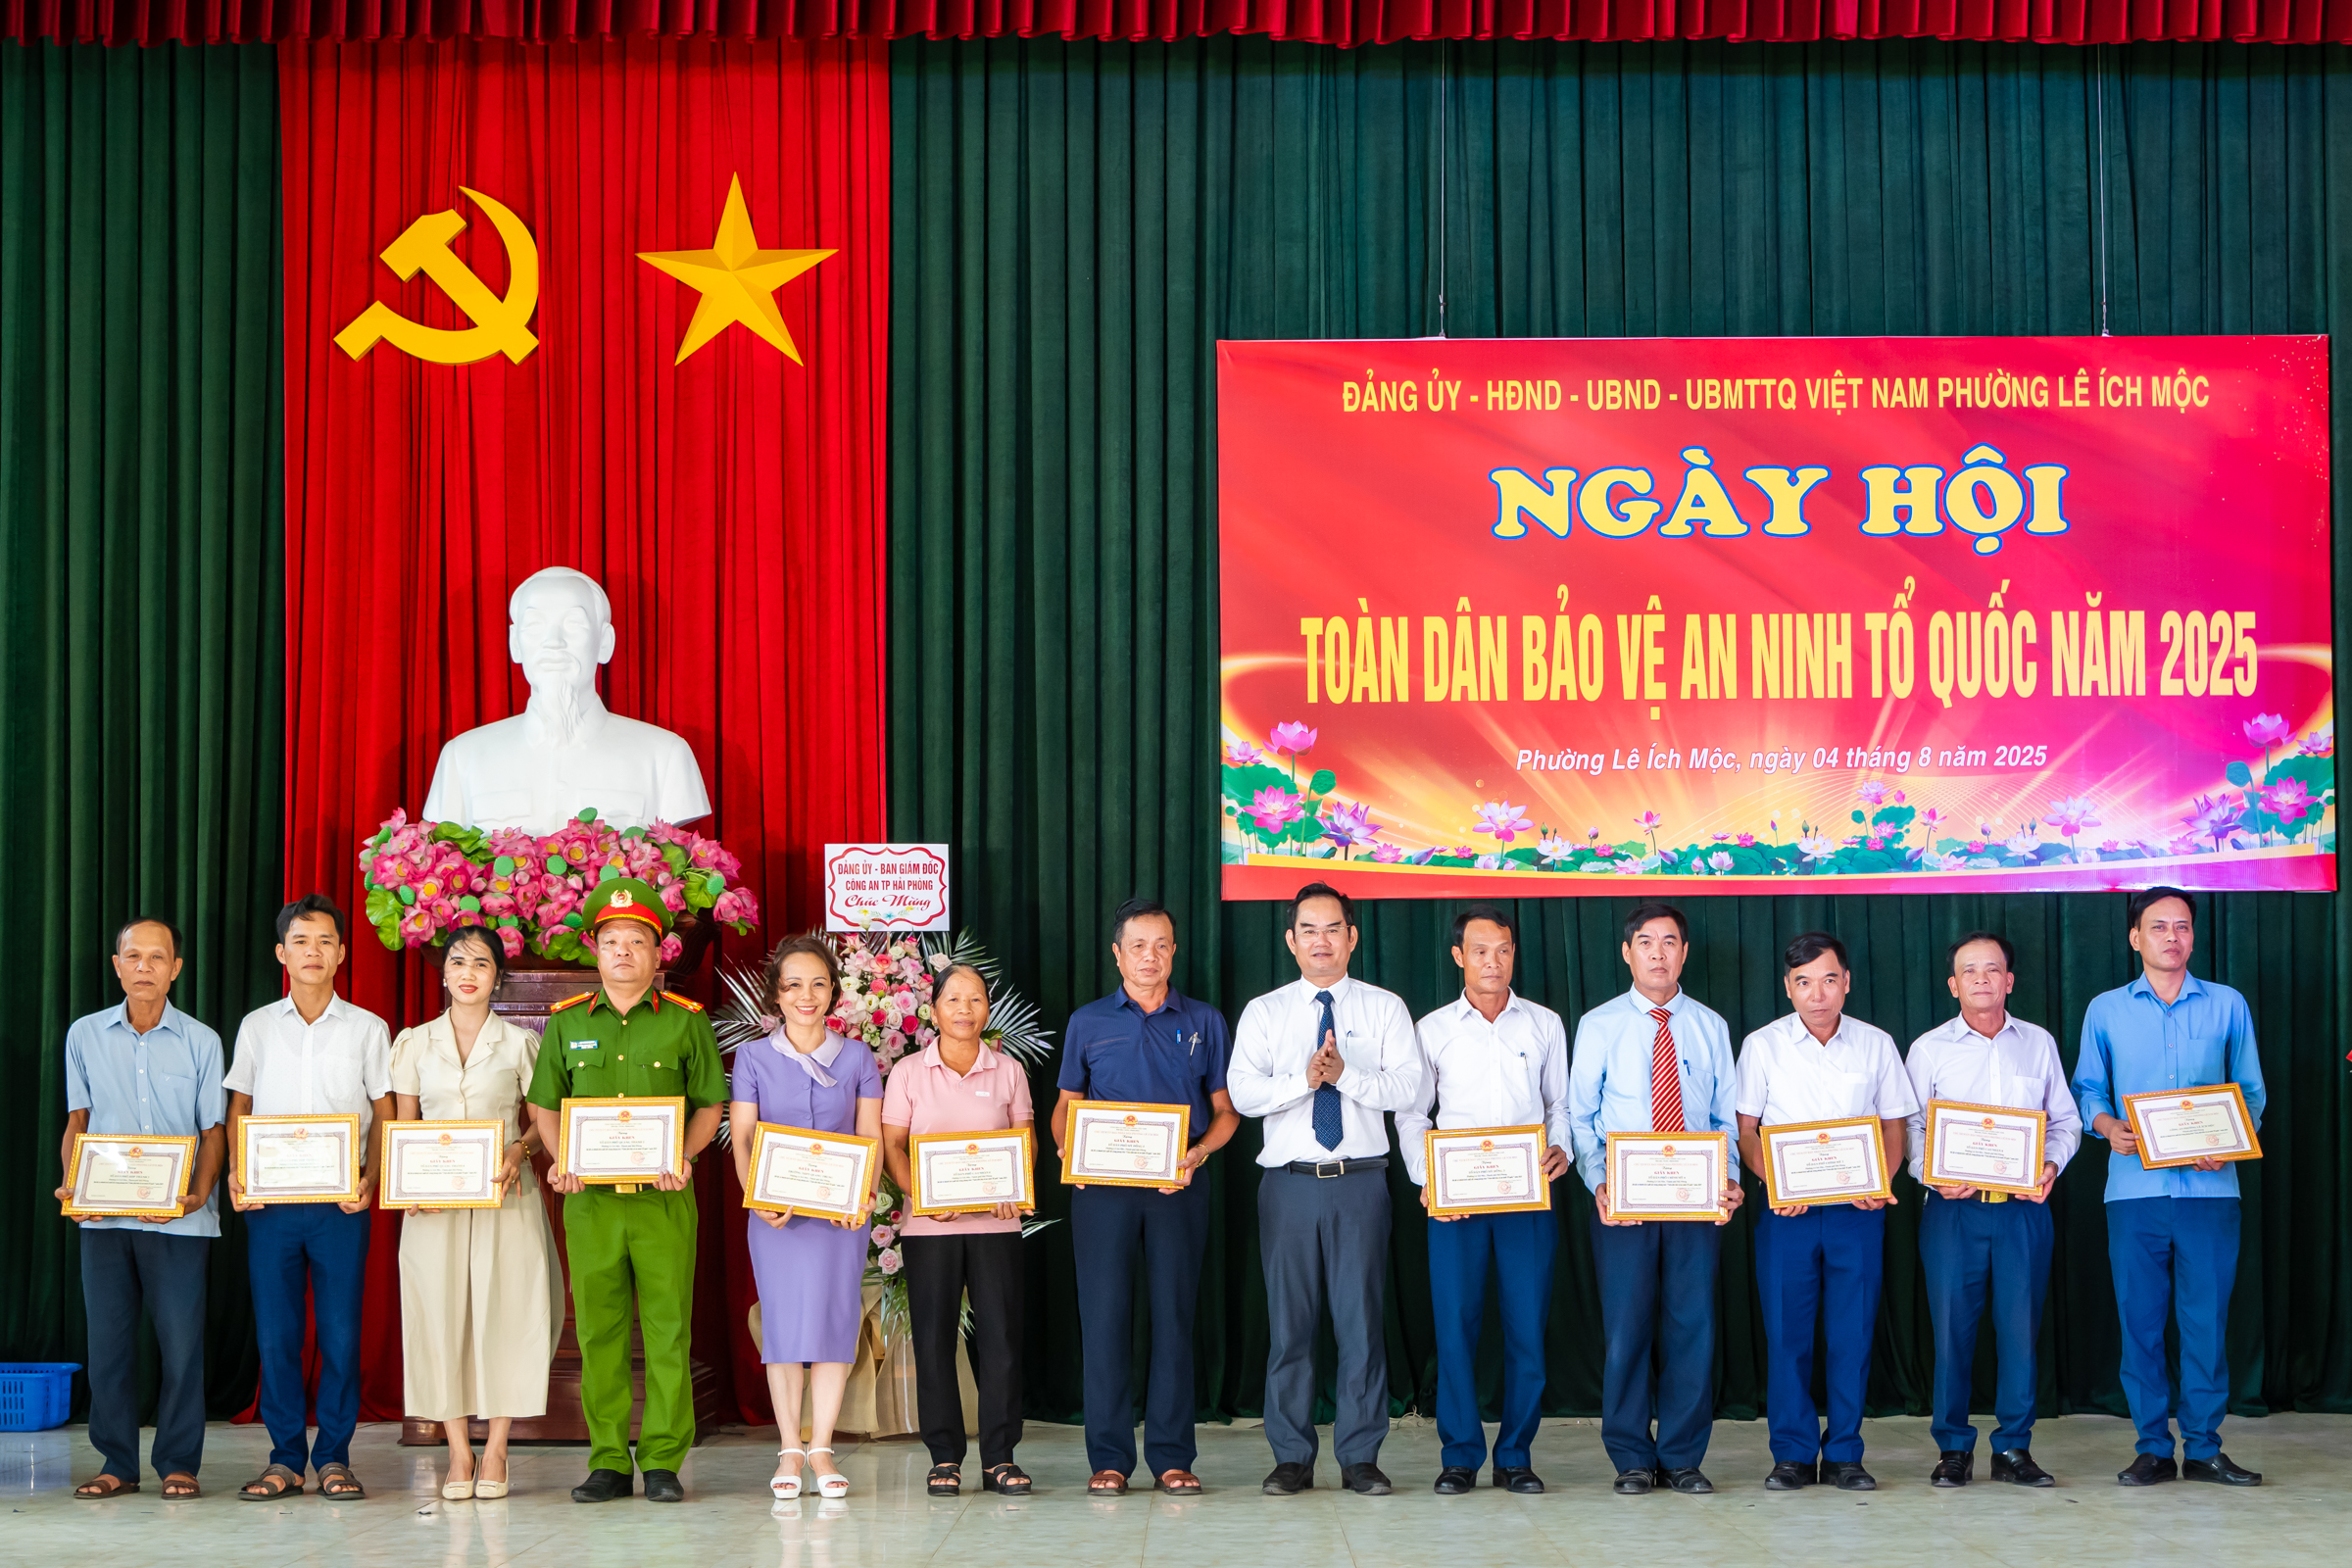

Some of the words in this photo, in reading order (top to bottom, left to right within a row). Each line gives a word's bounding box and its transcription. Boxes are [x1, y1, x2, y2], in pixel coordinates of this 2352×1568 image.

[1343, 368, 1417, 412] ĐẢNG
[1427, 368, 1461, 412] ỦY
[1470, 394, 1479, 403] -
[1487, 379, 1562, 411] HĐND
[1570, 394, 1579, 403] -
[1587, 379, 1661, 411] UBND
[1669, 393, 1678, 402] -
[1686, 378, 1796, 411] UBMTTQ
[1805, 369, 1863, 416] VIỆT
[1872, 377, 1929, 409] NAM
[1938, 368, 2049, 409] PHƯỜNG
[2058, 368, 2090, 408] LÊ
[2098, 368, 2142, 408] ÍCH
[2151, 368, 2210, 414] MỘC
[1489, 446, 1832, 540] NGÀY
[1858, 442, 2071, 557] HỘI
[1300, 598, 1409, 704] TOÀN
[1423, 596, 1508, 703] DÂN
[1522, 584, 1604, 702] BẢO
[1616, 595, 1666, 720] VỆ
[1680, 613, 1738, 700] AN
[1751, 612, 1852, 700] NINH
[1865, 575, 1915, 699] TỔ
[1929, 579, 2037, 709] QUỐC
[2051, 591, 2146, 698] NĂM
[2159, 610, 2258, 698] 2025
[1516, 748, 1608, 775] Phường
[1612, 748, 1642, 771] Lê
[1646, 743, 1682, 771] Ích
[1689, 746, 1741, 774] Mộc,
[1749, 746, 1806, 774] ngày
[1812, 747, 1838, 768] 04
[1845, 746, 1910, 774] tháng
[1918, 746, 1932, 767] 8
[1937, 746, 1988, 767] năm
[1993, 745, 2047, 767] 2025
[838, 859, 860, 875] ĐẢNG
[862, 859, 872, 875] ỦY
[880, 862, 898, 875] BAN
[899, 860, 920, 875] GIÁM
[922, 859, 939, 875] ĐỐC
[845, 878, 867, 891] CÔNG
[868, 880, 879, 891] AN
[881, 880, 891, 891] TP
[893, 876, 906, 891] HẢI
[907, 877, 933, 891] PHÒNG
[845, 895, 879, 907] Chúc
